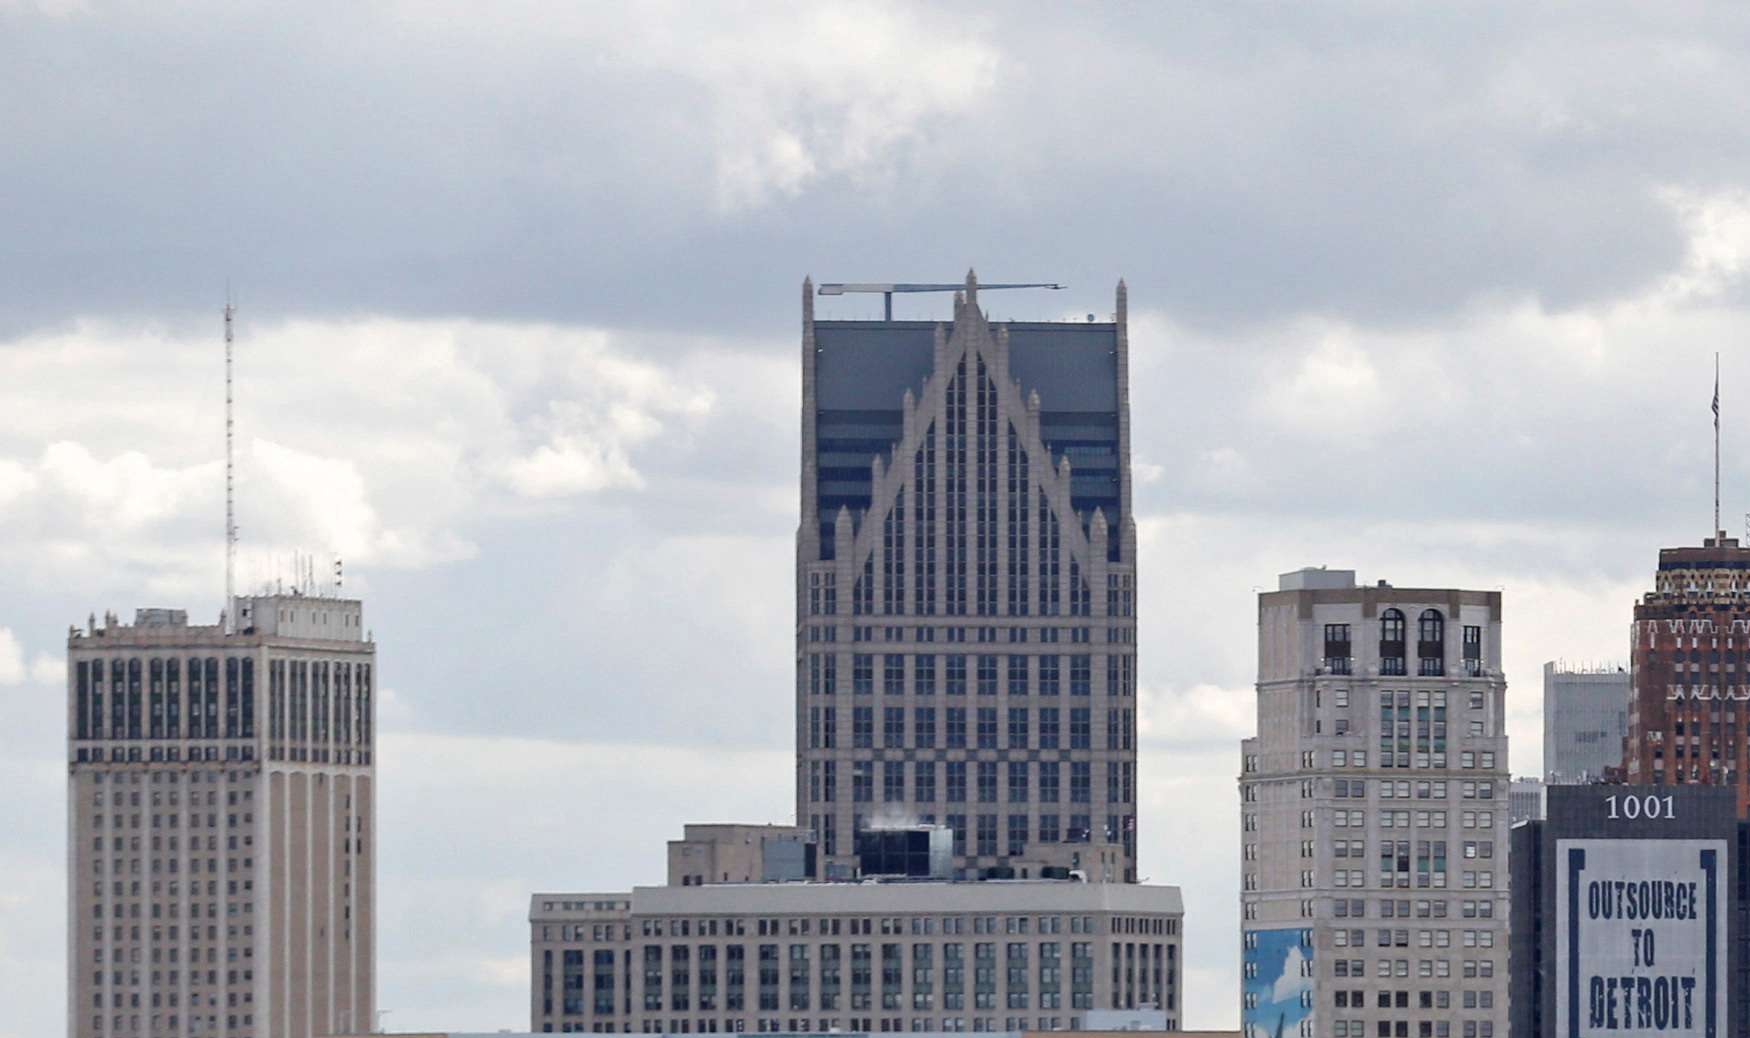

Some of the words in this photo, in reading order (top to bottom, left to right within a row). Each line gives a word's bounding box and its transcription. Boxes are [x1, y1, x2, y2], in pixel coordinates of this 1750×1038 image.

[1605, 795, 1676, 819] 1001
[1588, 881, 1697, 920] OUTSOURCE
[1631, 928, 1655, 967] TO
[1589, 975, 1697, 1030] DETROIT
